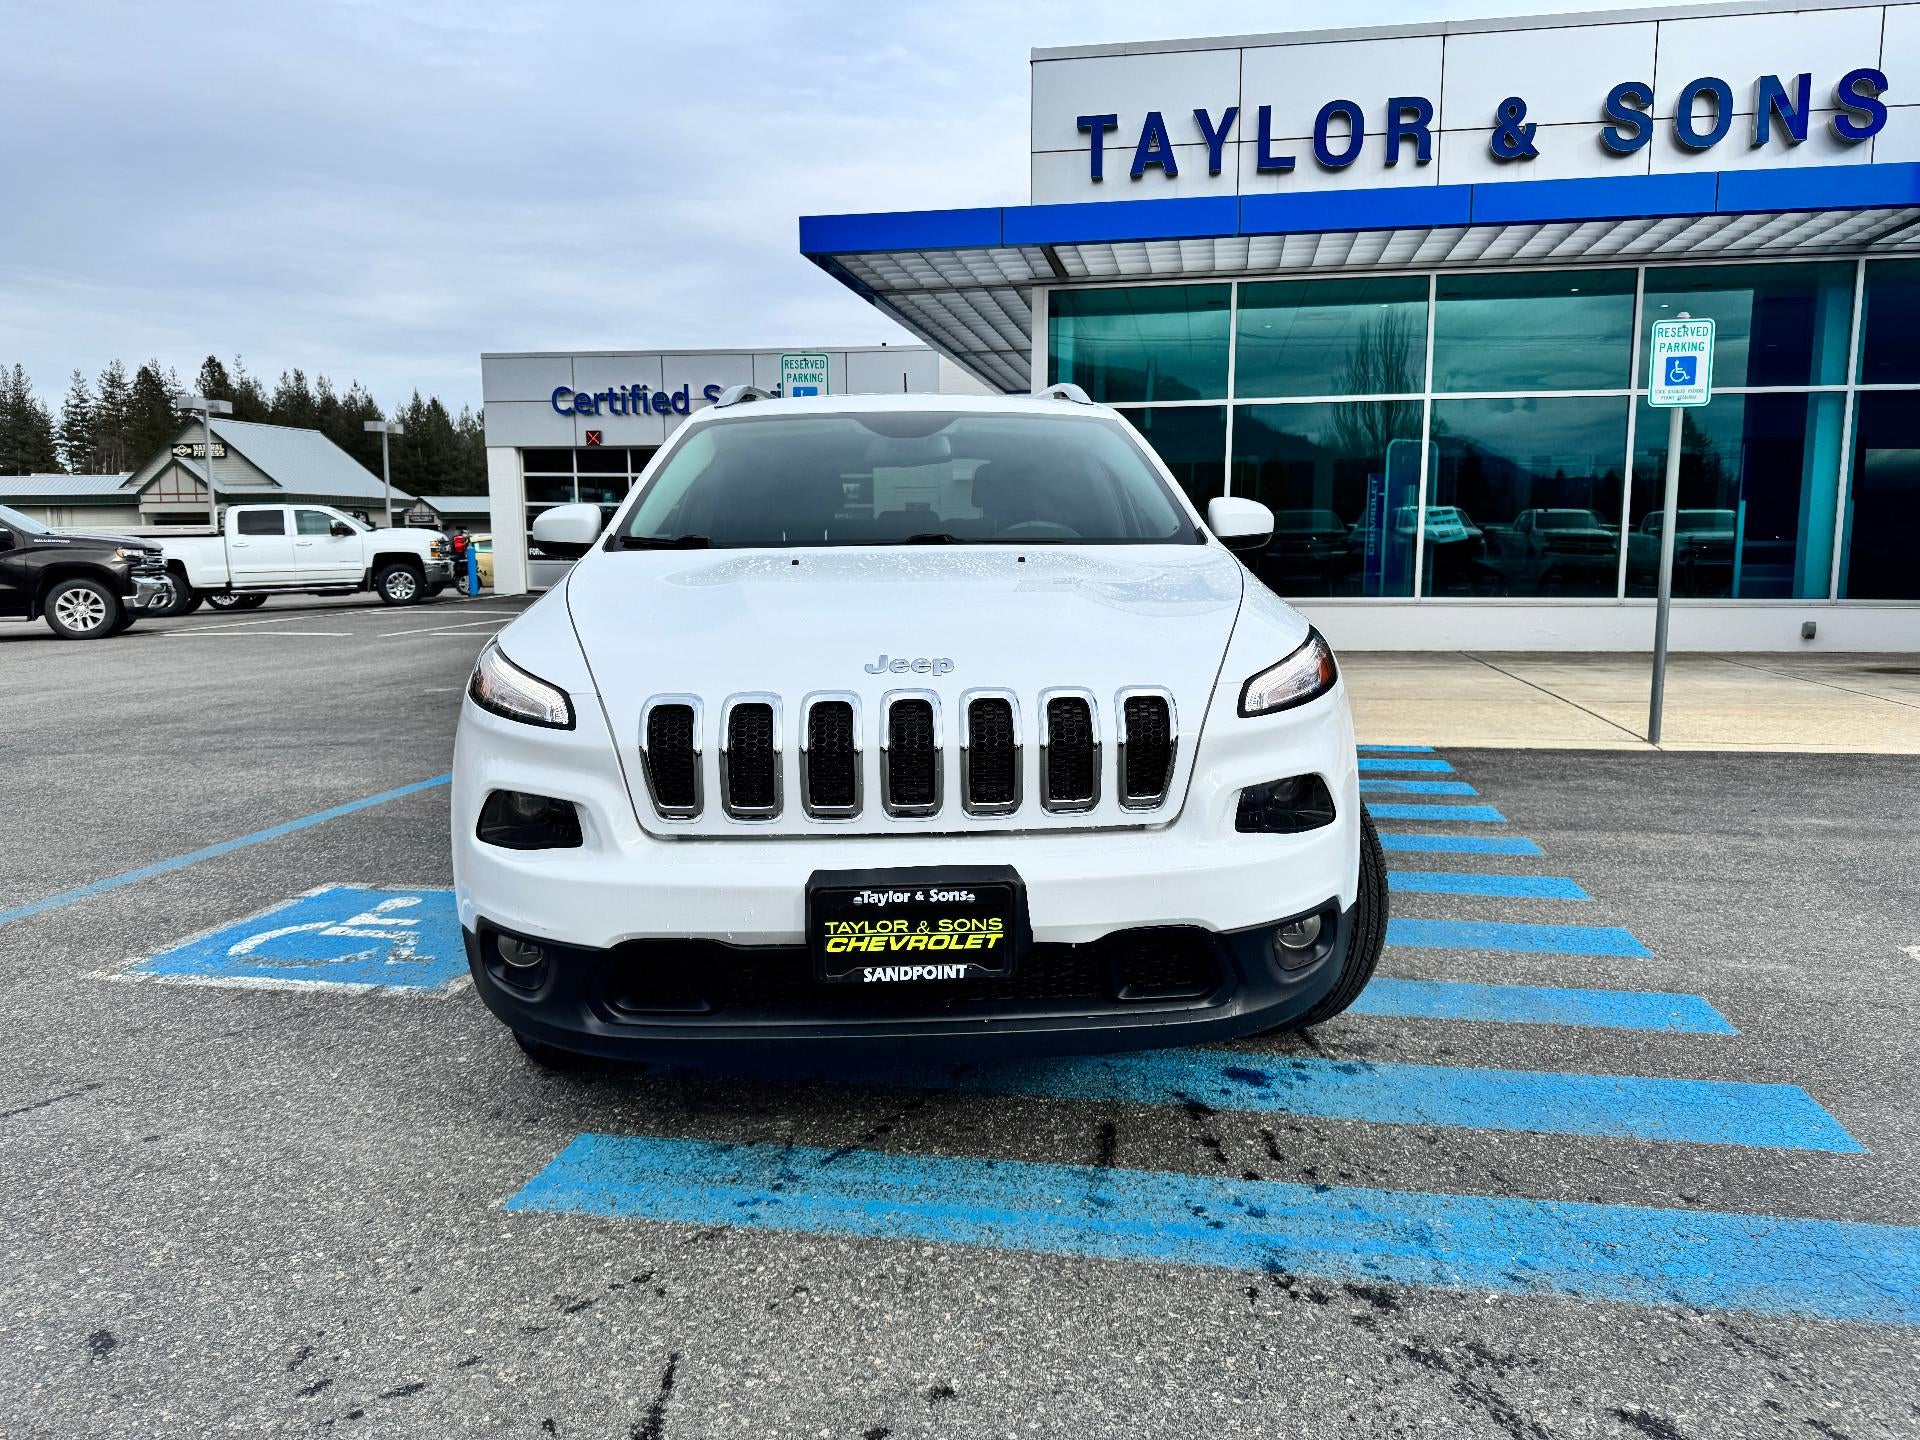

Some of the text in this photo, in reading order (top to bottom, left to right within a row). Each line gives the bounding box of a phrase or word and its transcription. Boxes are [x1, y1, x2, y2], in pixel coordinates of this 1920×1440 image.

[1076, 68, 1888, 183] TAYLOR & SONS
[1657, 326, 1709, 338] RESERVED
[1659, 341, 1705, 353] PARKING
[784, 359, 825, 370] RESERVED
[786, 373, 824, 383] PARKING
[551, 383, 691, 416] Certified
[1369, 479, 1379, 556] CHEVROLET
[864, 654, 955, 677] Jeep
[860, 889, 968, 907] Taylor & Sons
[825, 918, 1003, 935] TAYLOR & SONS
[826, 934, 1003, 953] CHEVROLET
[863, 964, 968, 983] SANDPOINT
